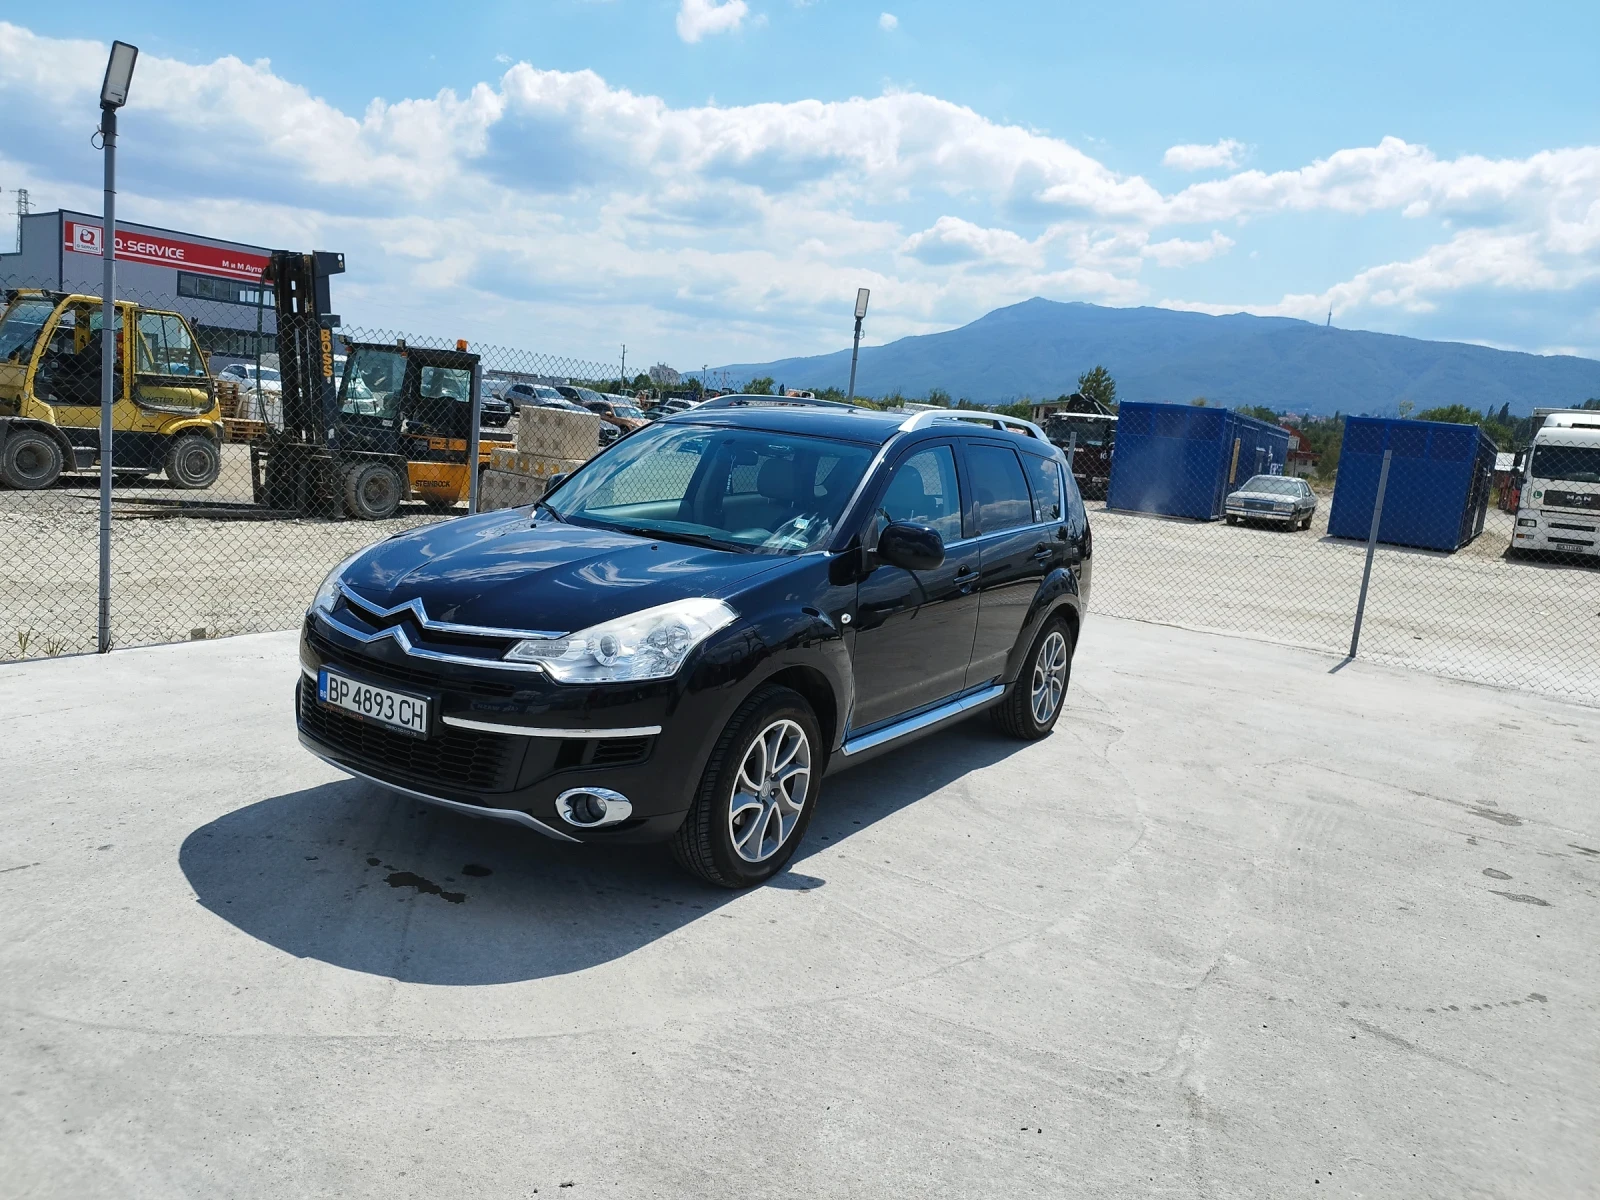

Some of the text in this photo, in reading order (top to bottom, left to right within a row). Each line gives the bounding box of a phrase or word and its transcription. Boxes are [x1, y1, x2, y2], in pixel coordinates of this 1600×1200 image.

[321, 329, 333, 377] BOSS
[415, 480, 451, 488] STEINBOCK
[1566, 494, 1592, 502] MAN
[329, 677, 349, 704] BP
[352, 687, 395, 720] 4893
[399, 699, 423, 730] CH
